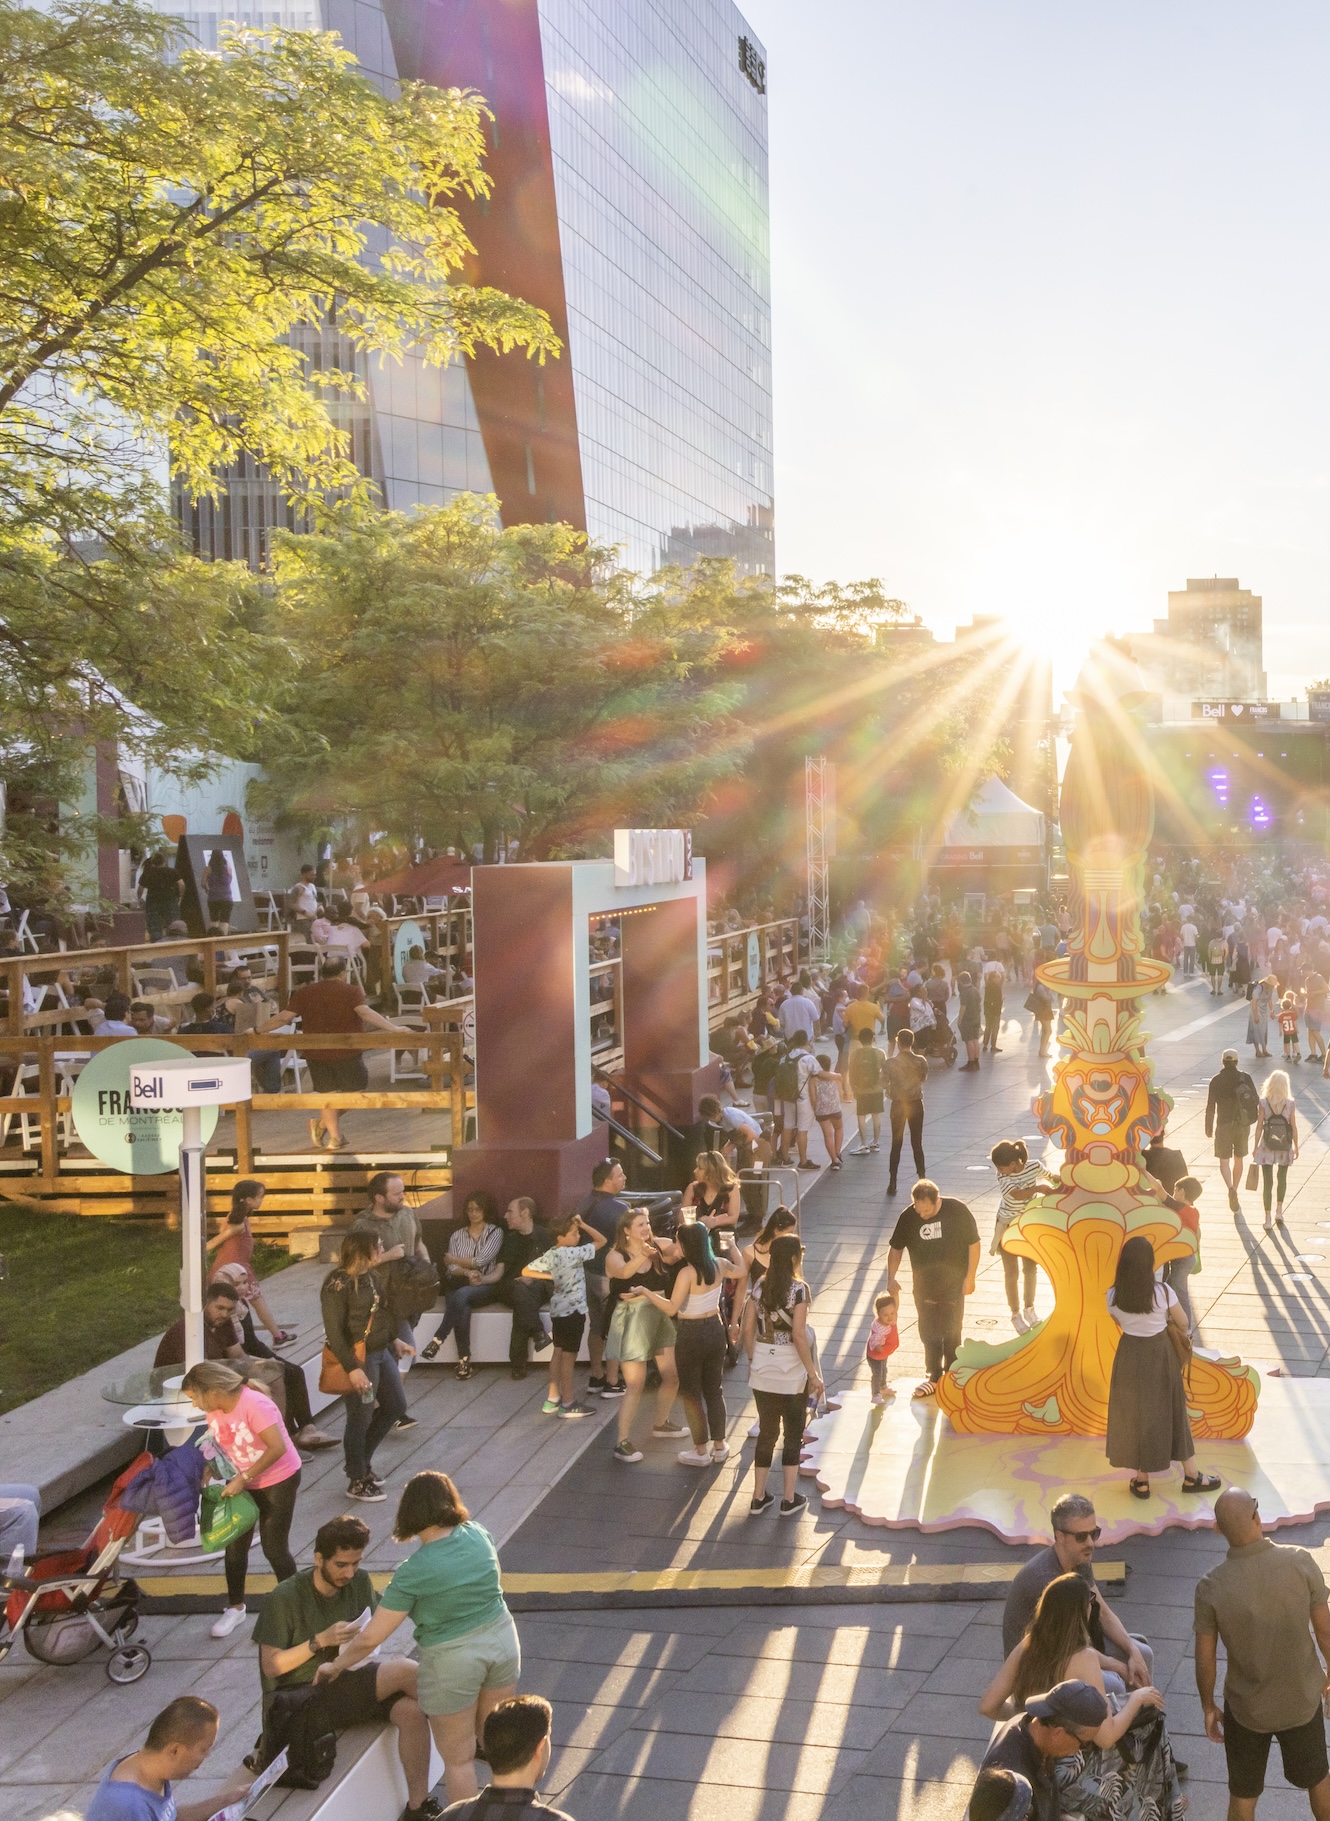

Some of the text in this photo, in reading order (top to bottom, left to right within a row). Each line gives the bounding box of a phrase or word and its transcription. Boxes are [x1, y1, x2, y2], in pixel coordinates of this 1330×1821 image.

[1202, 704, 1225, 717] Bell
[629, 829, 684, 886] BISTRO
[969, 851, 984, 860] Bell
[1283, 1020, 1294, 1031] 31
[134, 1076, 163, 1098] Bell
[99, 1117, 115, 1126] DE
